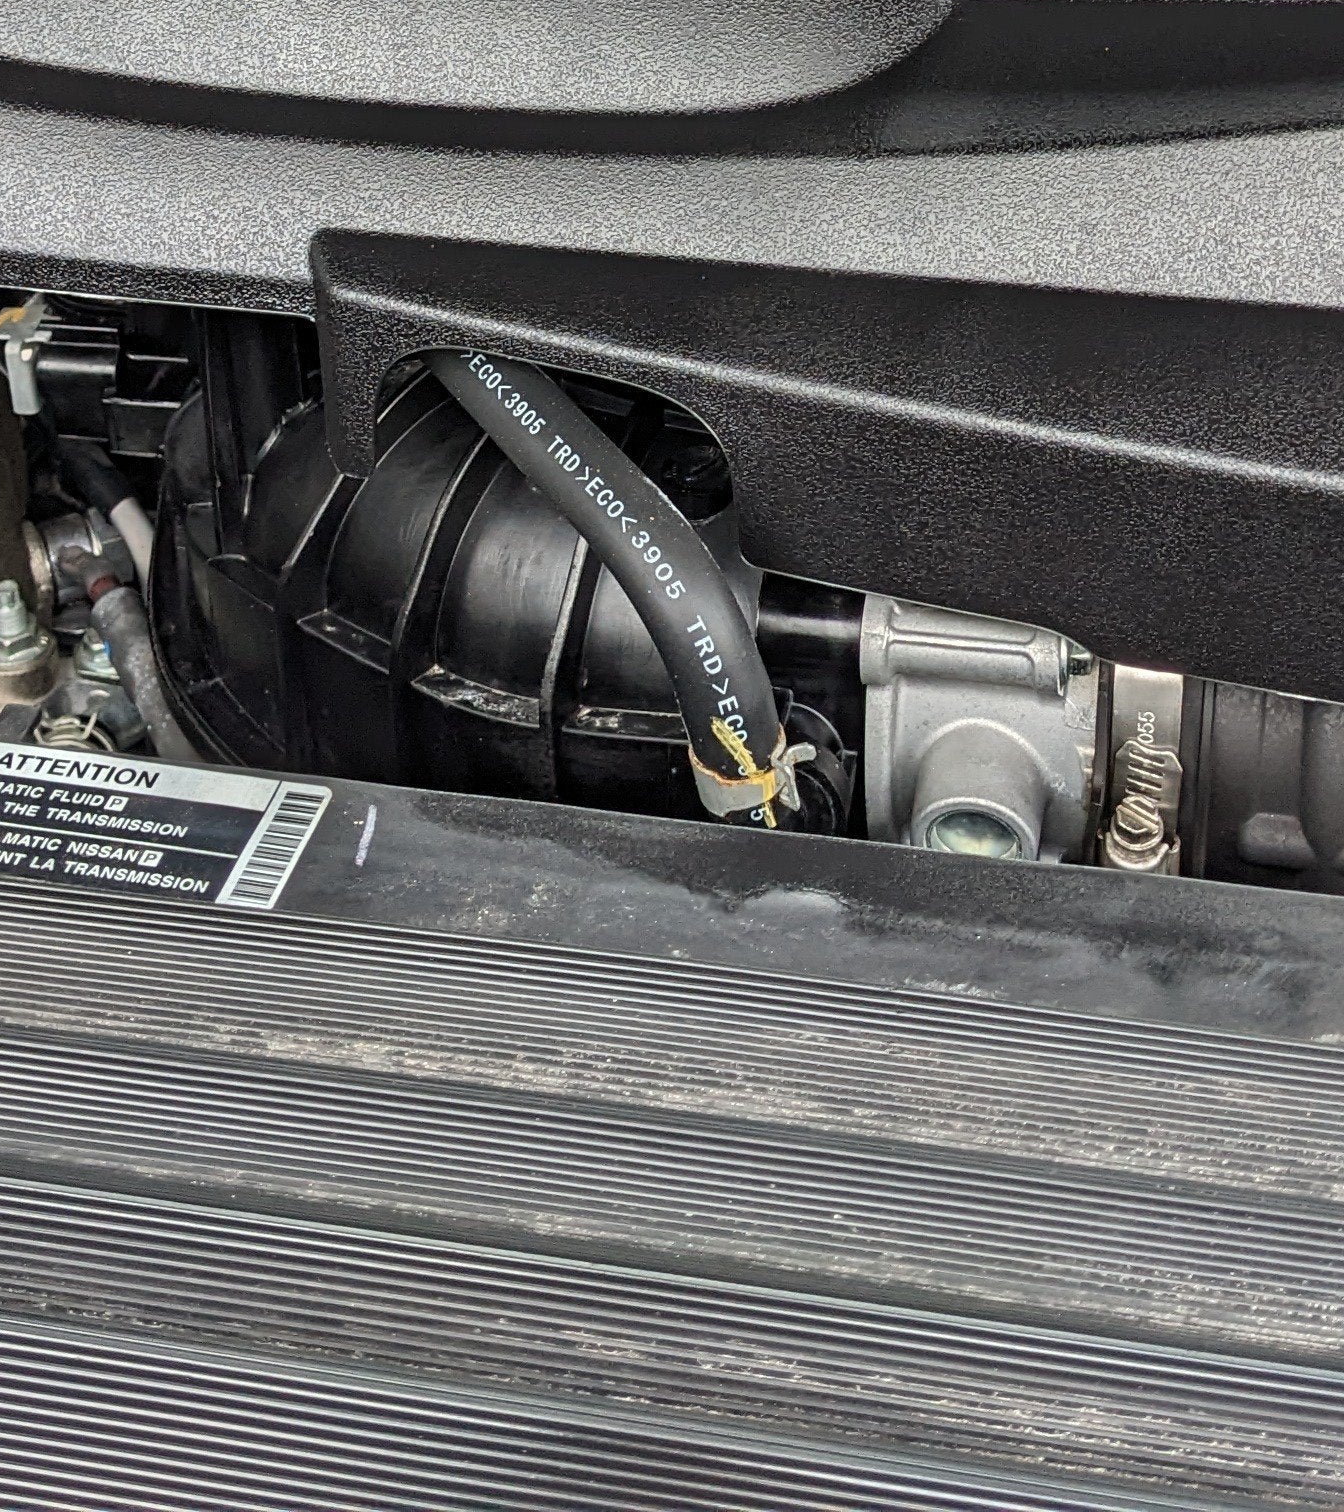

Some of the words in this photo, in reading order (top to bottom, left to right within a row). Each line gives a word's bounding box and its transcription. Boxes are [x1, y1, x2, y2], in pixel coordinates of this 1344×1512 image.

[49, 787, 106, 807] FLUID
[3, 801, 40, 818] THE
[46, 807, 190, 838] TRANSMISSION
[2, 831, 62, 852] MATIC
[65, 840, 141, 862] NISSAN
[29, 855, 57, 871] LA
[63, 861, 210, 894] TRANSMISSION
